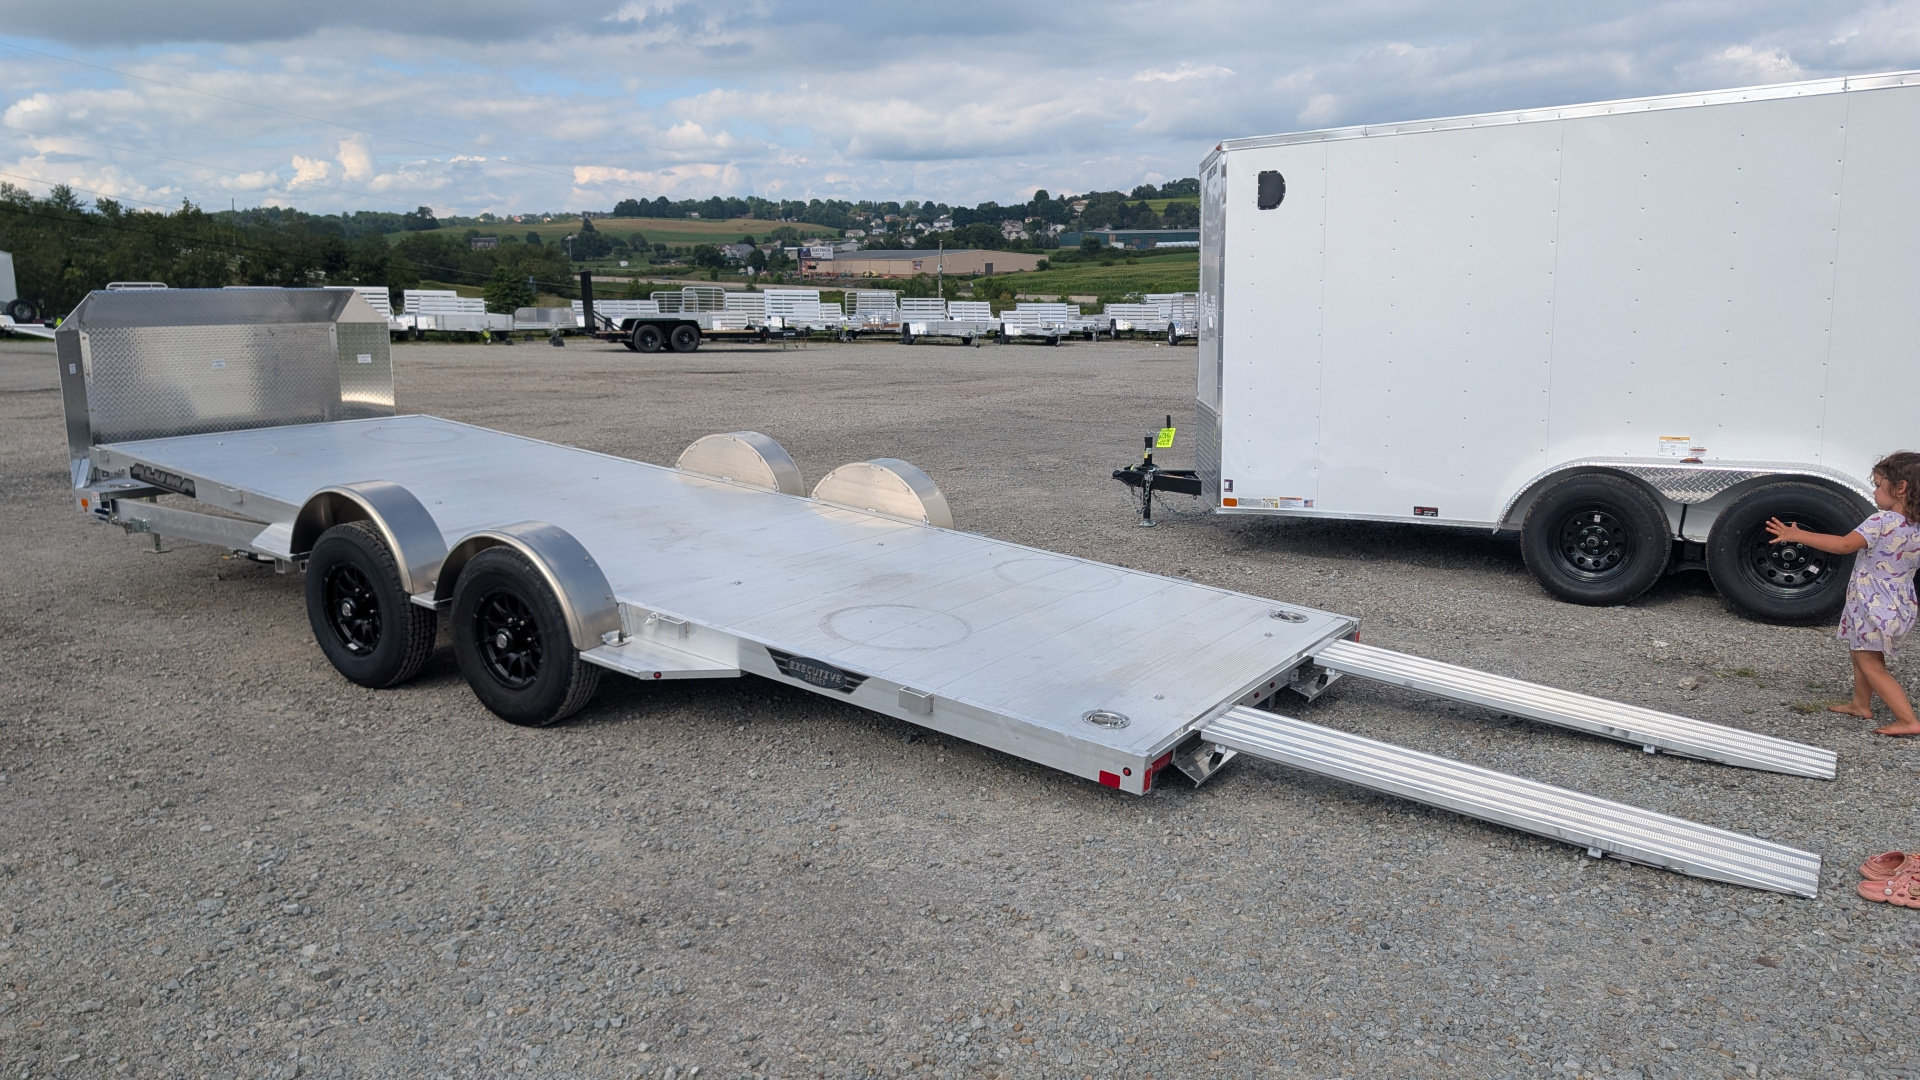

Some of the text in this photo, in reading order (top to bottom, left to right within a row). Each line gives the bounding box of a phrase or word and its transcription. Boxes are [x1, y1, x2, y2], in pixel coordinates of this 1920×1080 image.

[131, 463, 195, 495] ALUMA
[789, 661, 843, 683] EXECUTIVE
[804, 674, 826, 686] SERIES
